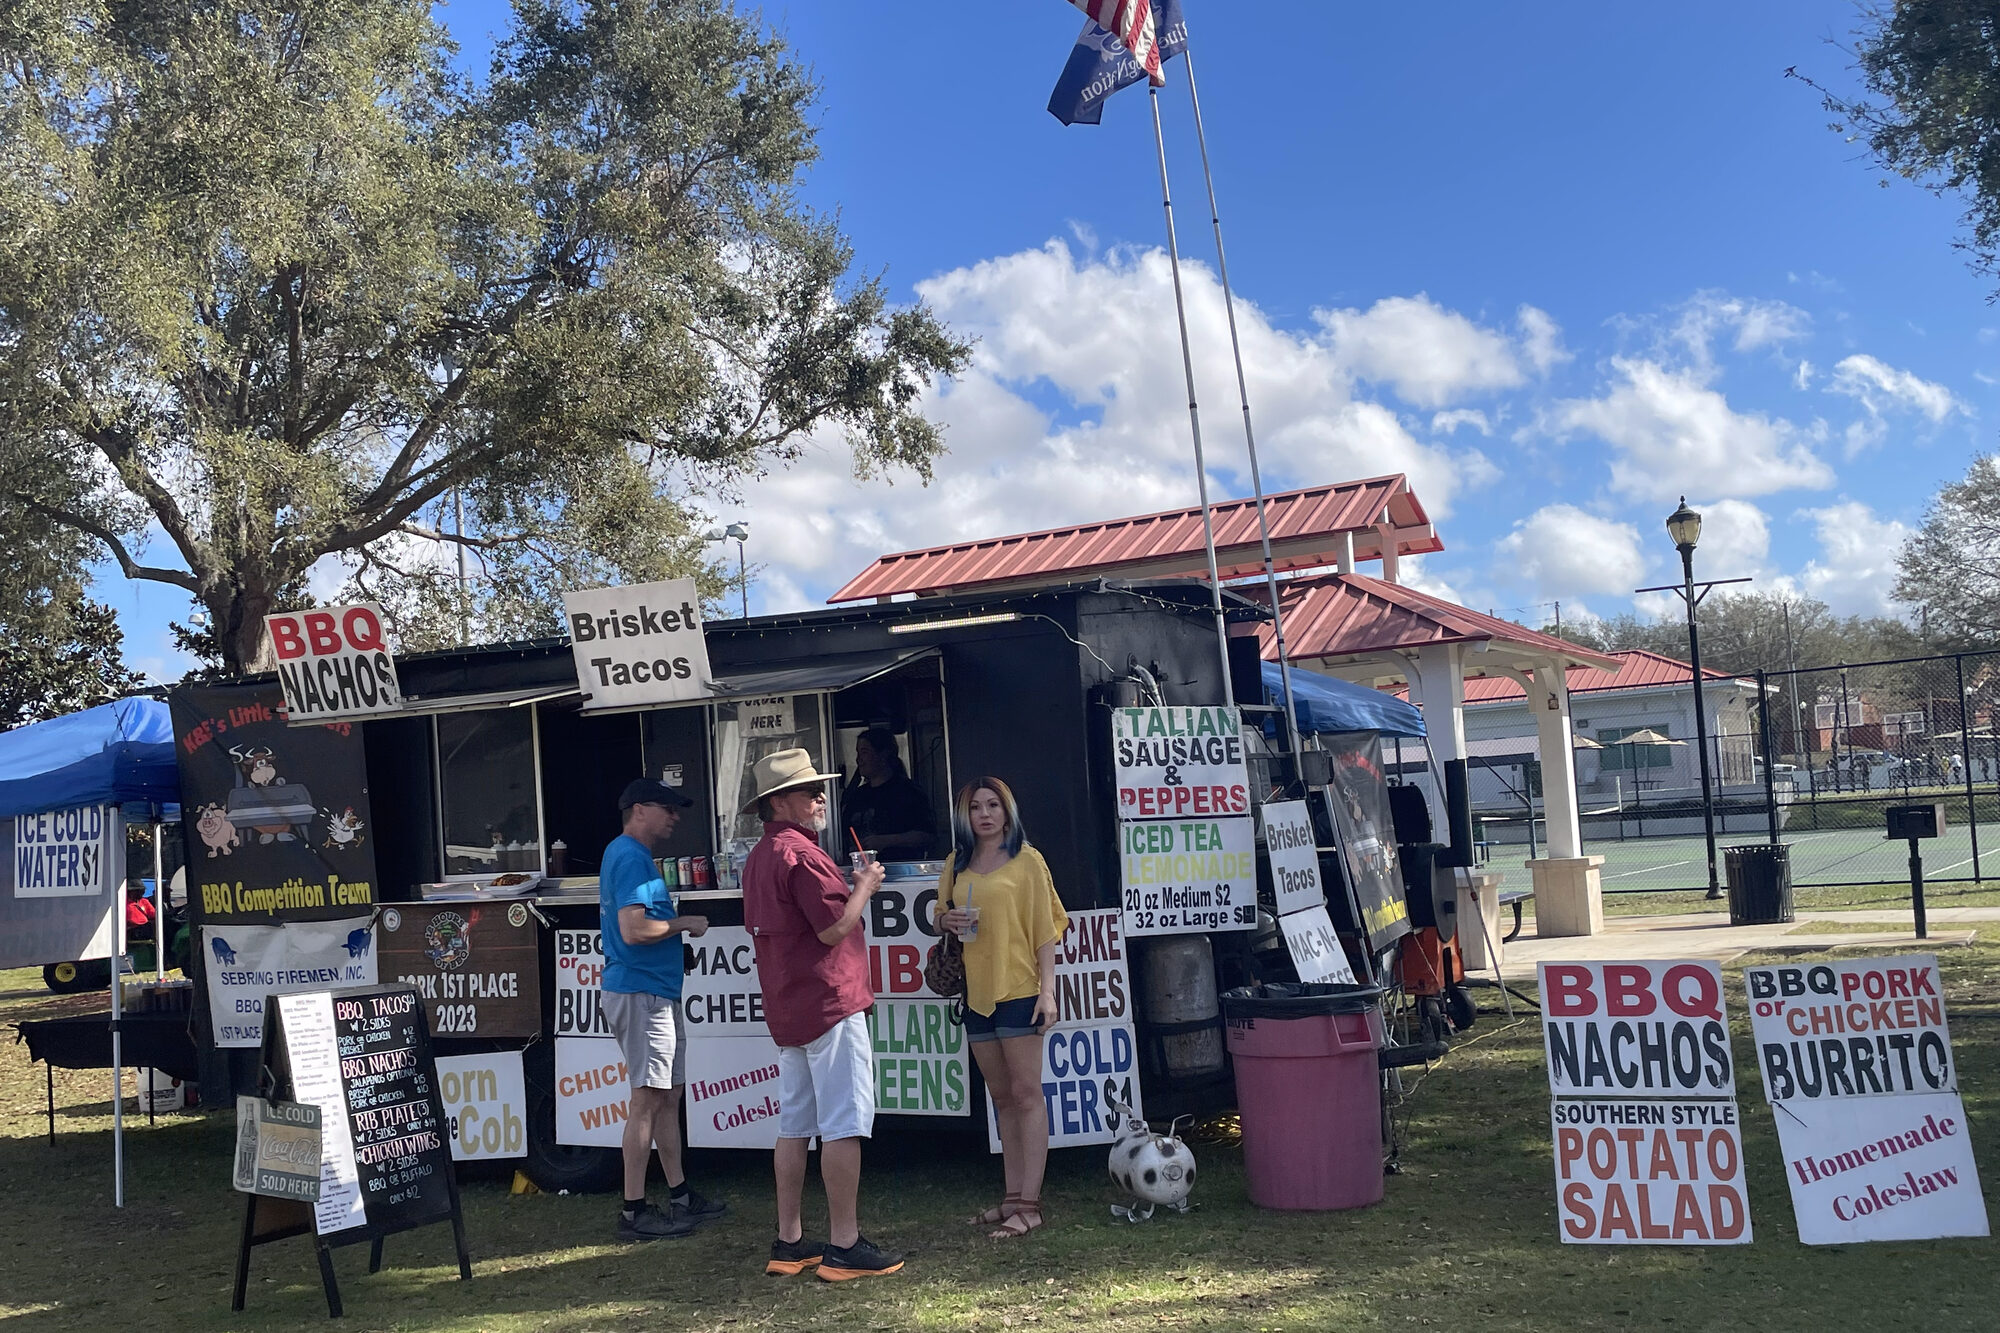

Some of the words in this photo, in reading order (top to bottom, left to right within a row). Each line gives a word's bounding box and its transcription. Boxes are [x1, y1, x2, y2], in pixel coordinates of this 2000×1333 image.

[268, 608, 386, 659] BBQ
[571, 602, 696, 643] Brisket
[278, 652, 395, 714] NACHOS
[592, 655, 691, 687] Tacos
[229, 702, 272, 728] Little
[751, 715, 782, 729] HERE
[1119, 737, 1241, 767] SAUSAGE
[1164, 766, 1182, 785] &
[1120, 785, 1247, 815] PEPPERS
[18, 813, 47, 843] ICE
[54, 806, 101, 842] COLD
[1125, 825, 1173, 854] ICED
[1180, 823, 1223, 851] TEA
[1267, 819, 1313, 852] Brisket
[18, 845, 79, 888] WATER
[1127, 852, 1251, 884] LEMONADE
[1278, 866, 1315, 894] Tacos
[201, 883, 232, 914] BBQ
[236, 877, 324, 916] Competition
[328, 874, 371, 905] Team
[1126, 888, 1140, 911] 20
[1145, 893, 1158, 910] oz
[1162, 886, 1211, 909] Medium
[1216, 883, 1231, 906] $2
[432, 912, 465, 929] HOURS
[1136, 912, 1154, 928] 32
[1160, 915, 1177, 927] oz
[1183, 910, 1228, 928] Large
[1288, 926, 1336, 964] MAC-N-
[221, 971, 274, 985] SEBRING
[277, 968, 342, 985] FIREMEN,
[345, 966, 365, 979] INC.
[435, 957, 448, 970] OF
[560, 957, 578, 968] or
[441, 972, 465, 999] 1ST
[469, 973, 518, 998] PLACE
[1544, 964, 1723, 1021] BBQ
[1749, 966, 1838, 999] BBQ
[1841, 967, 1937, 1002] PORK
[236, 1000, 263, 1013] BBQ
[337, 1002, 363, 1021] BBQ
[370, 995, 410, 1016] TACOS
[436, 1004, 477, 1032] 2023
[1756, 1001, 1785, 1018] or
[1785, 998, 1942, 1037] CHICKEN
[220, 1026, 235, 1039] 1ST
[237, 1026, 261, 1039] PLACE
[338, 1036, 355, 1046] PORK
[366, 1031, 391, 1043] CHICKEN
[403, 1026, 414, 1035] $12
[362, 1019, 369, 1031] 2
[370, 1017, 391, 1030] SIDES
[340, 1044, 364, 1056] BRISKET
[342, 1059, 366, 1079] BBQ
[368, 1050, 417, 1074] NACHOS
[1049, 1028, 1132, 1078] COLD
[1548, 1020, 1731, 1089] NACHOS
[1763, 1031, 1947, 1100] BURRITO
[348, 1085, 375, 1100] BRISKET
[414, 1073, 426, 1084] $15
[350, 1097, 368, 1110] PORK
[378, 1090, 405, 1103] CHICKEN
[417, 1084, 428, 1094] $10
[442, 1069, 498, 1104] orn
[286, 1107, 314, 1123] COLD
[355, 1111, 379, 1132] RIB
[381, 1105, 419, 1127] PLATE
[417, 1102, 429, 1117] (3)
[459, 1103, 523, 1155] Cob
[1554, 1104, 1665, 1125] SOUTHERN
[1671, 1104, 1735, 1125] STYLE
[367, 1130, 374, 1142] 2
[376, 1126, 397, 1140] SIDES
[407, 1120, 421, 1131] ONLY
[362, 1139, 404, 1165] CHICKEN
[405, 1132, 440, 1155] WINGS
[389, 1159, 395, 1172] 2
[397, 1154, 418, 1170] SIDES
[1559, 1127, 1738, 1181] POTATO
[1791, 1113, 1958, 1186] Homemade
[261, 1175, 286, 1192] SOLD
[288, 1177, 315, 1195] HERE
[368, 1178, 387, 1192] BBQ
[400, 1164, 432, 1184] BUFFALO
[389, 1191, 405, 1204] ONLY
[407, 1184, 421, 1198] $12
[1832, 1166, 1959, 1222] Coleslaw
[1563, 1182, 1745, 1240] SALAD
